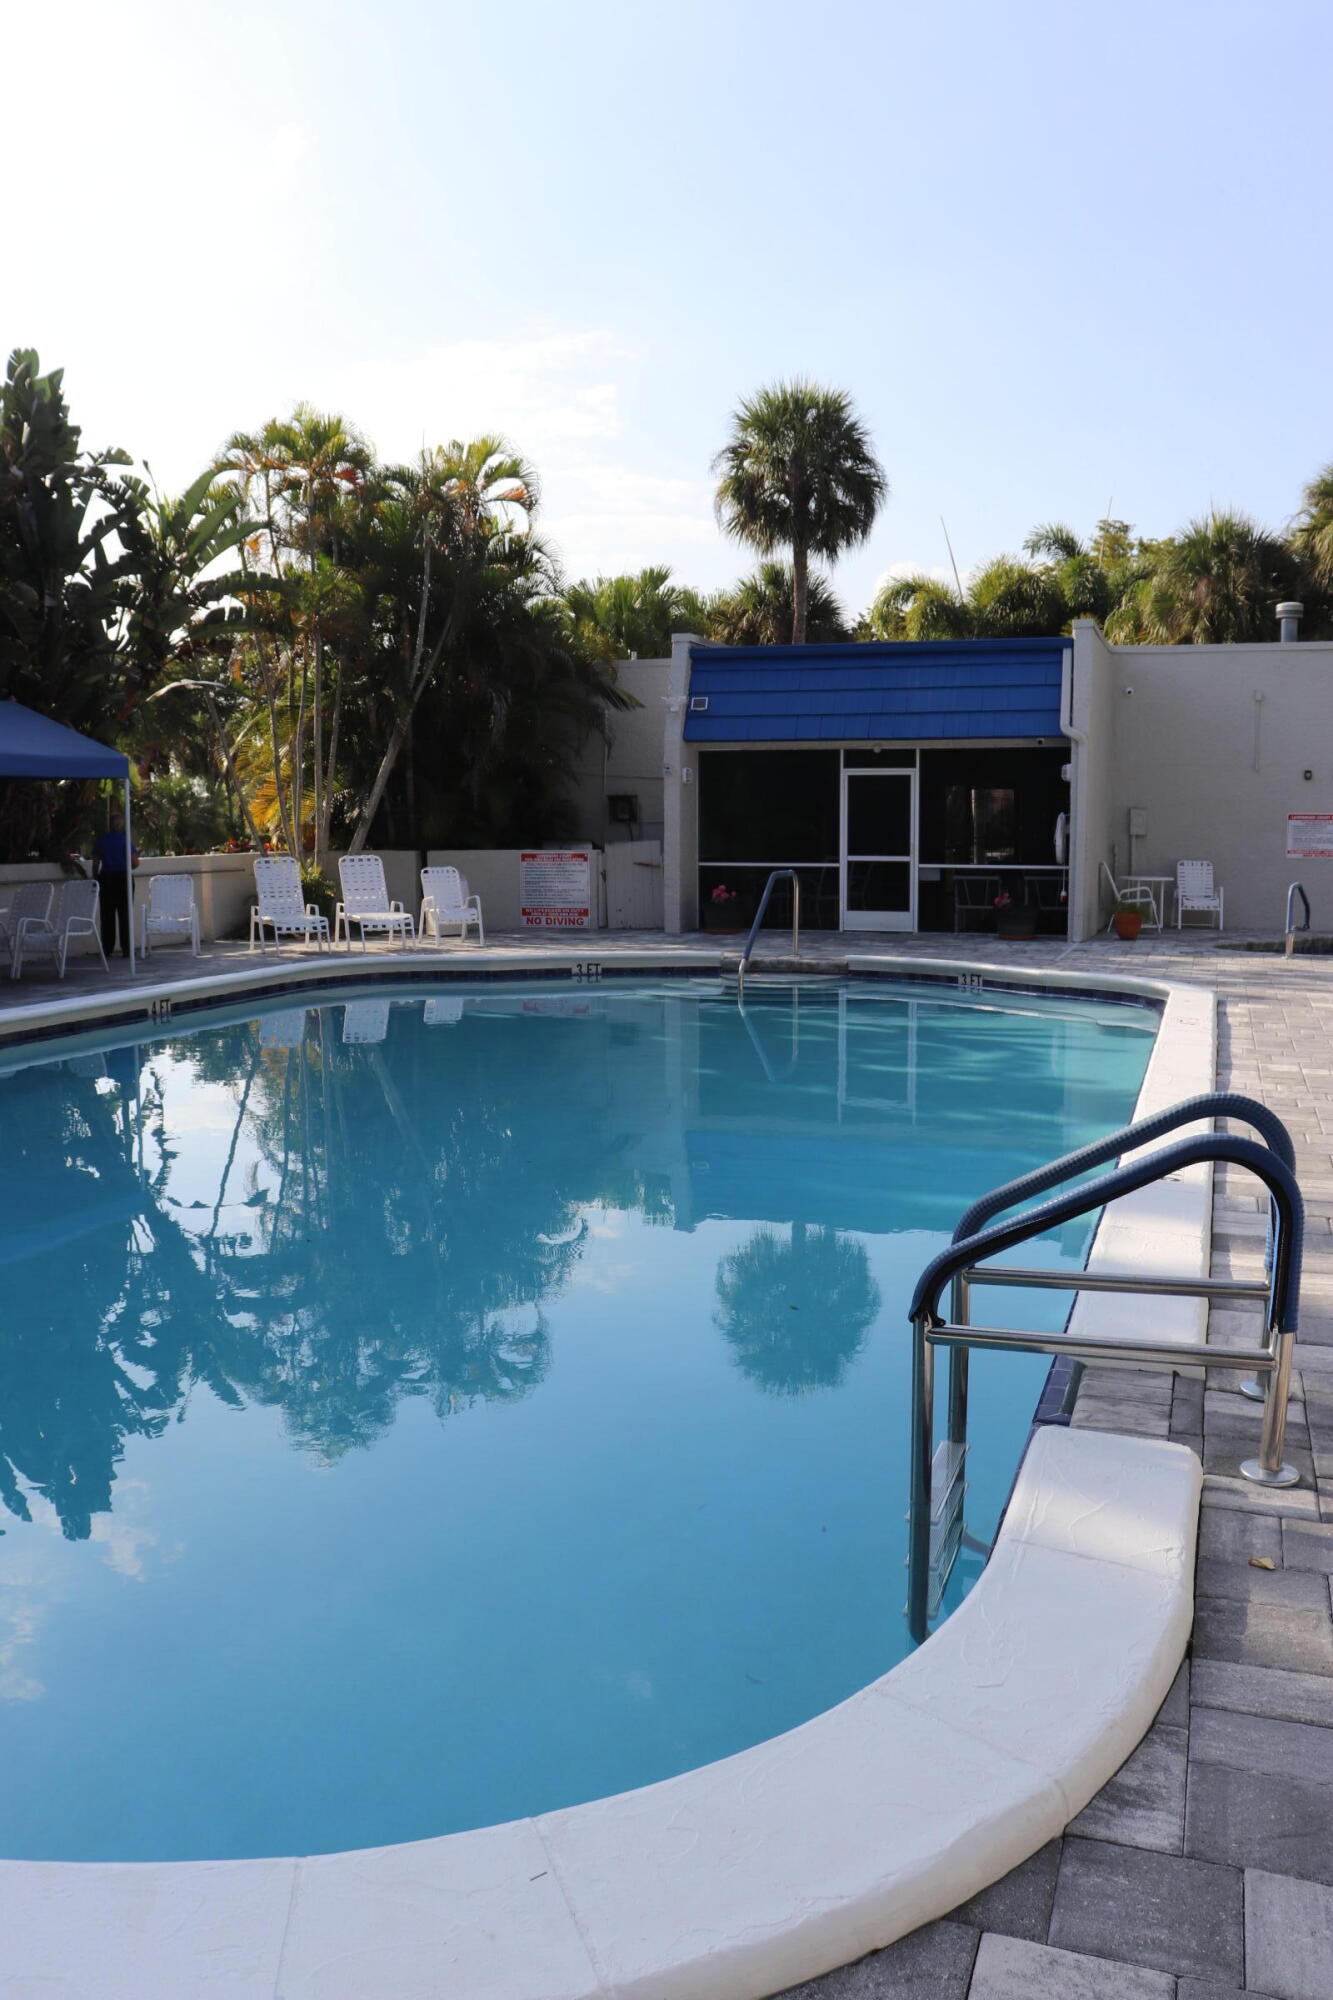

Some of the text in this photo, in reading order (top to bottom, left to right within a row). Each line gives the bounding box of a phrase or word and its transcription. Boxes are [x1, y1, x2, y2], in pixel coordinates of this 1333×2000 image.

[526, 917, 584, 926] NO DIVING
[576, 963, 601, 975] 3 FT
[961, 973, 982, 986] 3 FT
[160, 998, 171, 1014] FT
